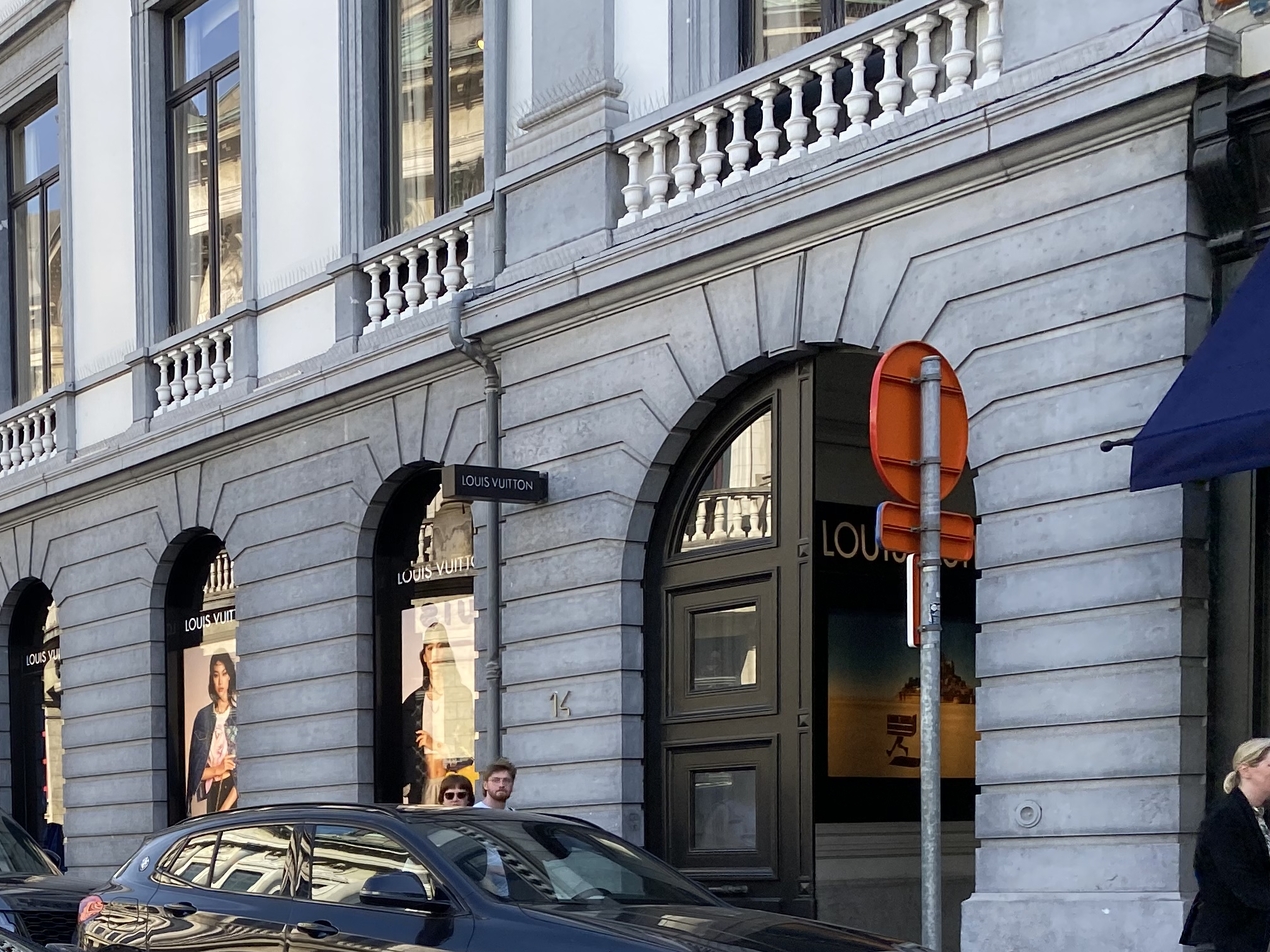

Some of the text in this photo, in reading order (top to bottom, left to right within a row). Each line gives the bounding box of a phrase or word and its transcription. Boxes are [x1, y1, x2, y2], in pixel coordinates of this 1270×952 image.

[461, 475, 533, 491] LOUIS VUITTON
[397, 565, 432, 585] LOUIS
[185, 614, 211, 632] LOUIS
[26, 650, 47, 666] LOUIS
